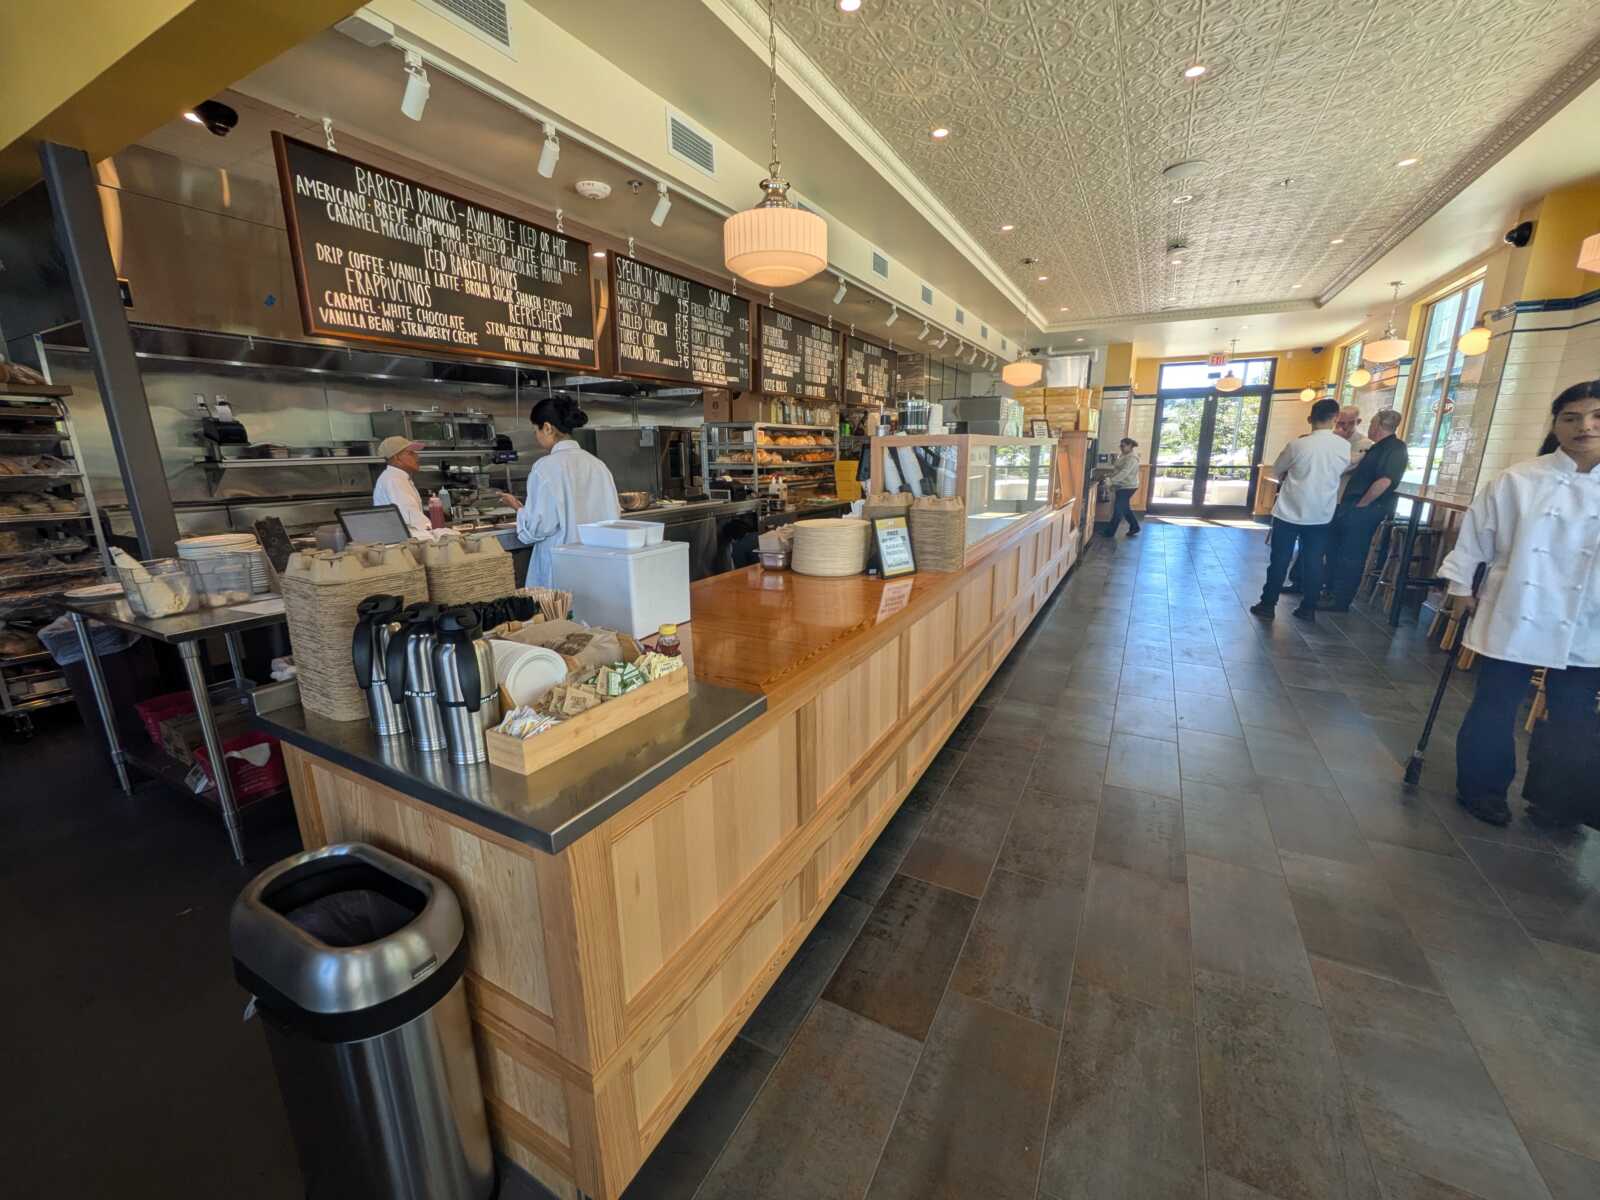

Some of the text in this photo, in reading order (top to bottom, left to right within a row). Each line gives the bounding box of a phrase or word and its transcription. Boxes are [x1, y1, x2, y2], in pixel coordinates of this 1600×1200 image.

[296, 174, 578, 276] AMERICANO BREVE CAPPUCINO ESPRESSO LATTE CHAI LATTE
[355, 166, 568, 258] BARISTA DRINKS AVAILABLE ICED OR HOT
[326, 202, 563, 285] CARAMEL MACCHIATO MOCHA WHITE CHOCOLATE MOCHA
[315, 242, 573, 318] DRIP COFFEE VANILLA LATTE BROWN SUGAR SHAKEN ESPRESSO
[423, 248, 518, 290] ICED BARISTA DRINKS
[616, 256, 690, 300] SPECIALTY SANDWICHES
[344, 267, 432, 308] FRAPPUCINOS
[617, 280, 641, 300] CHICKEN
[643, 287, 660, 305] SALAD
[709, 289, 730, 312] SALADS
[318, 307, 367, 329] VANILLA
[367, 315, 396, 333] BEAN
[401, 321, 451, 342] STRAWBERRY
[324, 290, 465, 331] CARAMEL WHITE CHOCOLATE
[508, 303, 562, 332] REFRESHERS
[618, 311, 643, 330] GRILLED
[644, 317, 668, 337] CHICKEN
[485, 321, 529, 342] STRAWBERRY
[504, 337, 521, 352] PINK
[619, 327, 640, 345] TURKEY
[642, 332, 655, 348] CLUB
[620, 343, 644, 360] AVOCADO
[644, 347, 660, 363] TOAST
